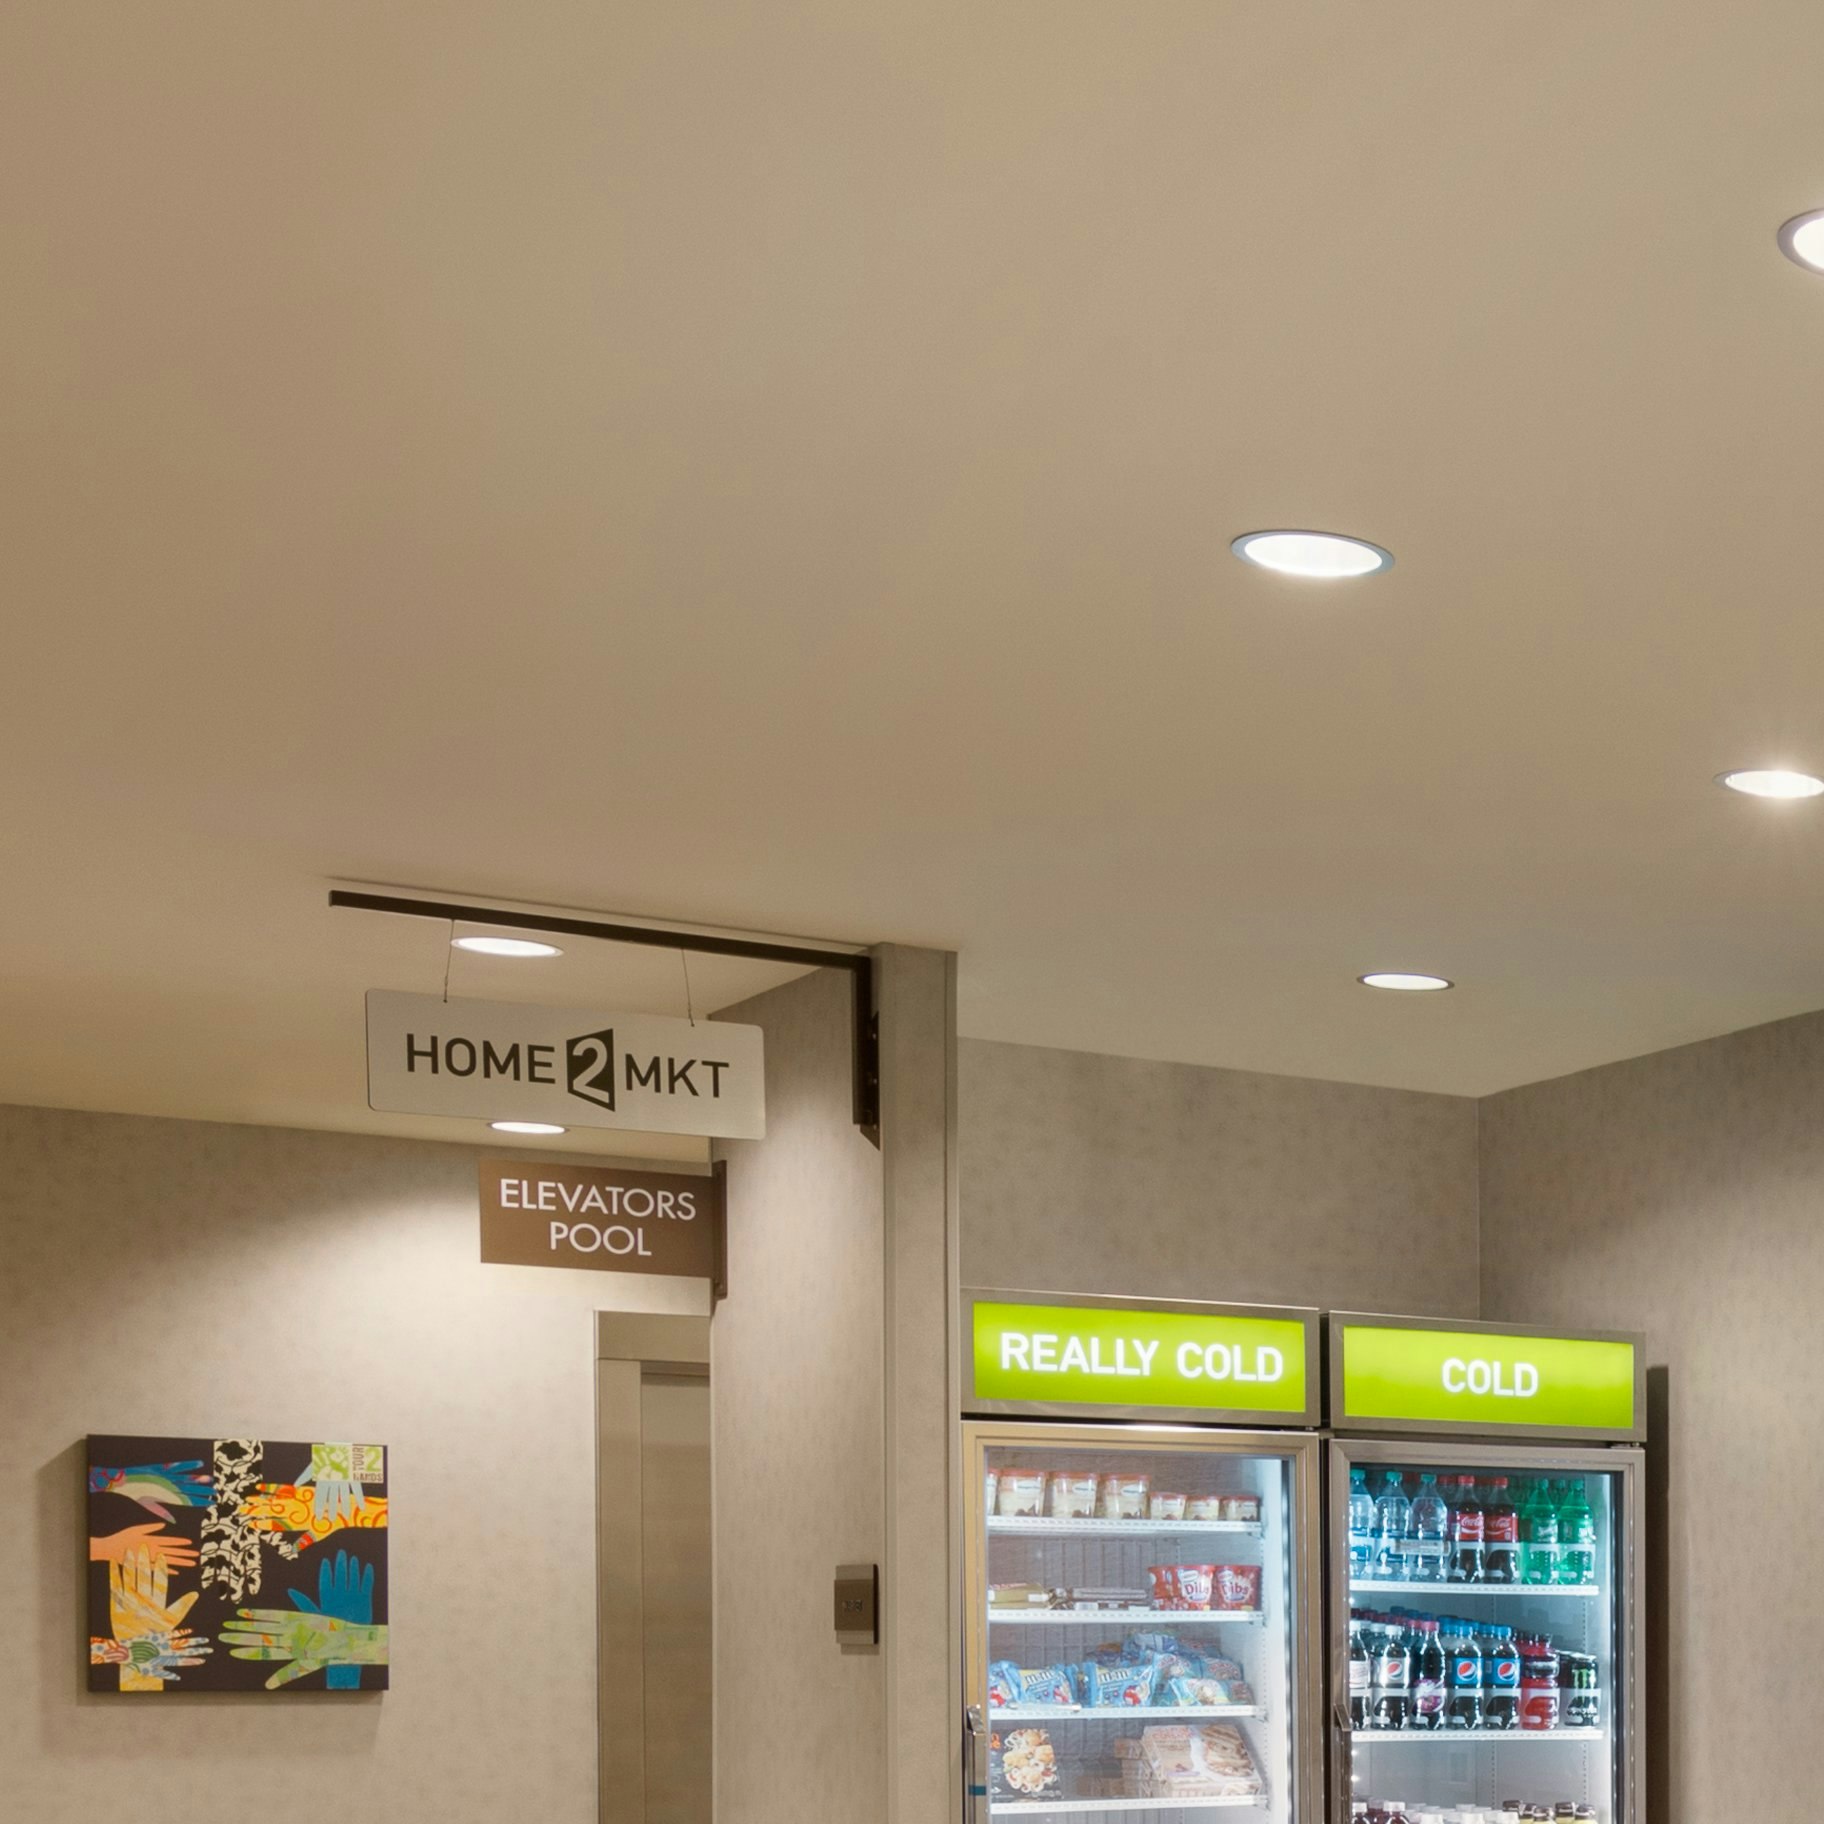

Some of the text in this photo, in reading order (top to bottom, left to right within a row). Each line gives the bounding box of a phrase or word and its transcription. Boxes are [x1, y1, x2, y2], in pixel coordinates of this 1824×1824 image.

[406, 1033, 556, 1084] HOME
[625, 1053, 730, 1099] MKT
[500, 1178, 696, 1221] ELEVATORS
[550, 1221, 652, 1256] POOL
[1000, 1332, 1284, 1382] REALLY COLD
[1441, 1357, 1540, 1397] COLD
